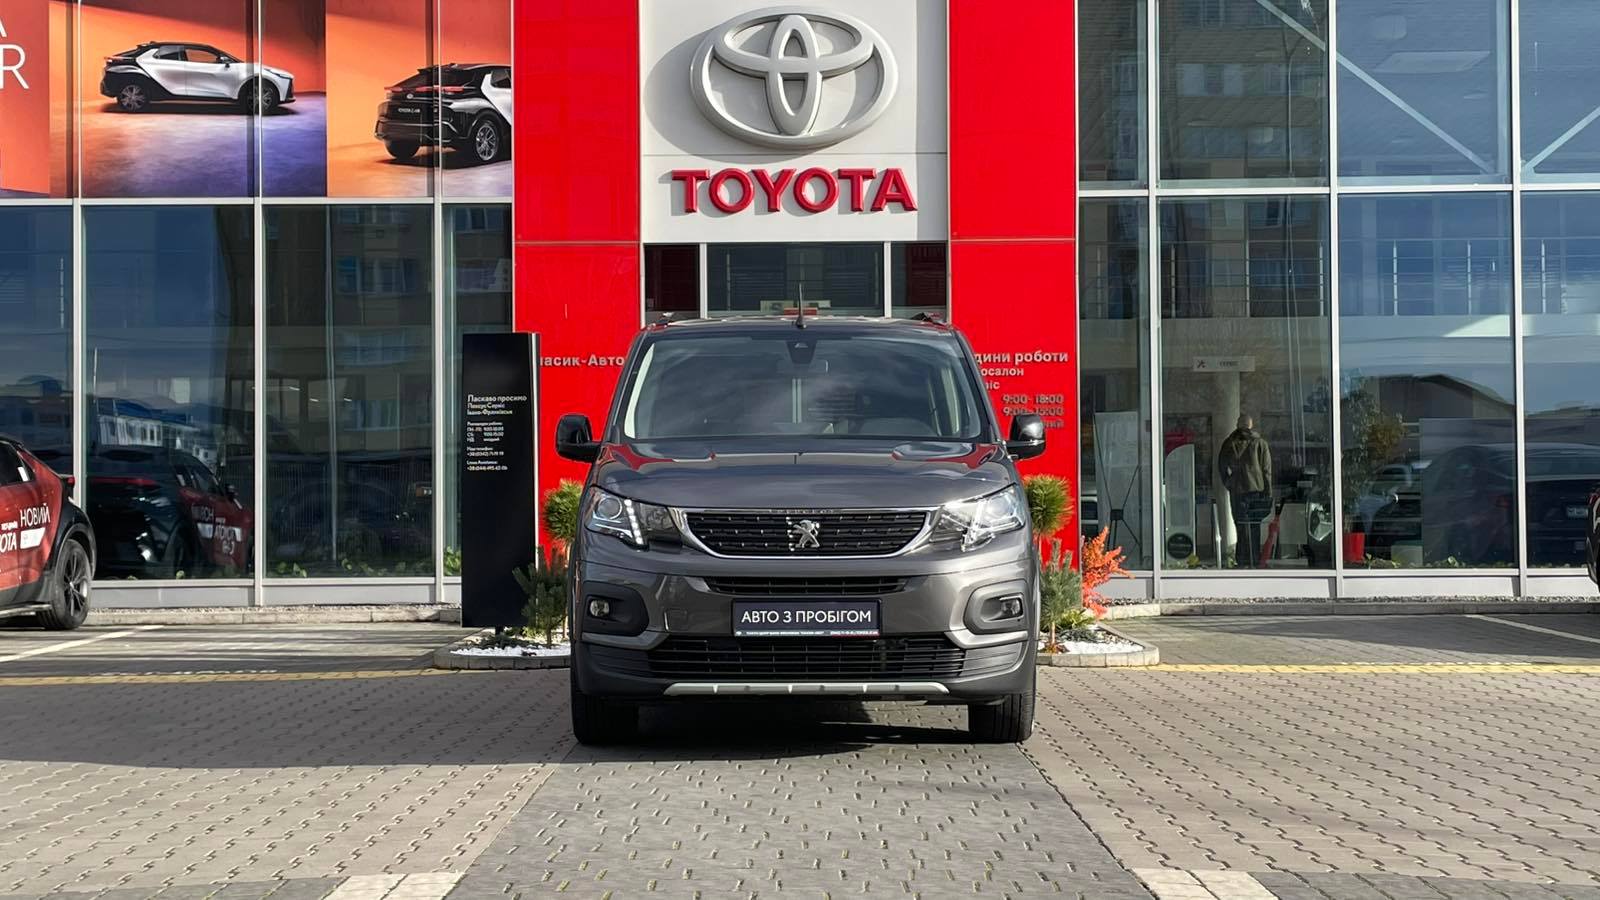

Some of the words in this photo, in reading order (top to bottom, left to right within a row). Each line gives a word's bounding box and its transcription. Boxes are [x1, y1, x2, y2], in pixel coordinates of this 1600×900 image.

[671, 167, 918, 213] TOYOTA
[1014, 349, 1068, 365] роботи
[19, 503, 51, 527] НОВИЙ
[741, 610, 779, 624] АВТО
[783, 610, 792, 624] З
[795, 610, 872, 624] ПРОБІГОМ
